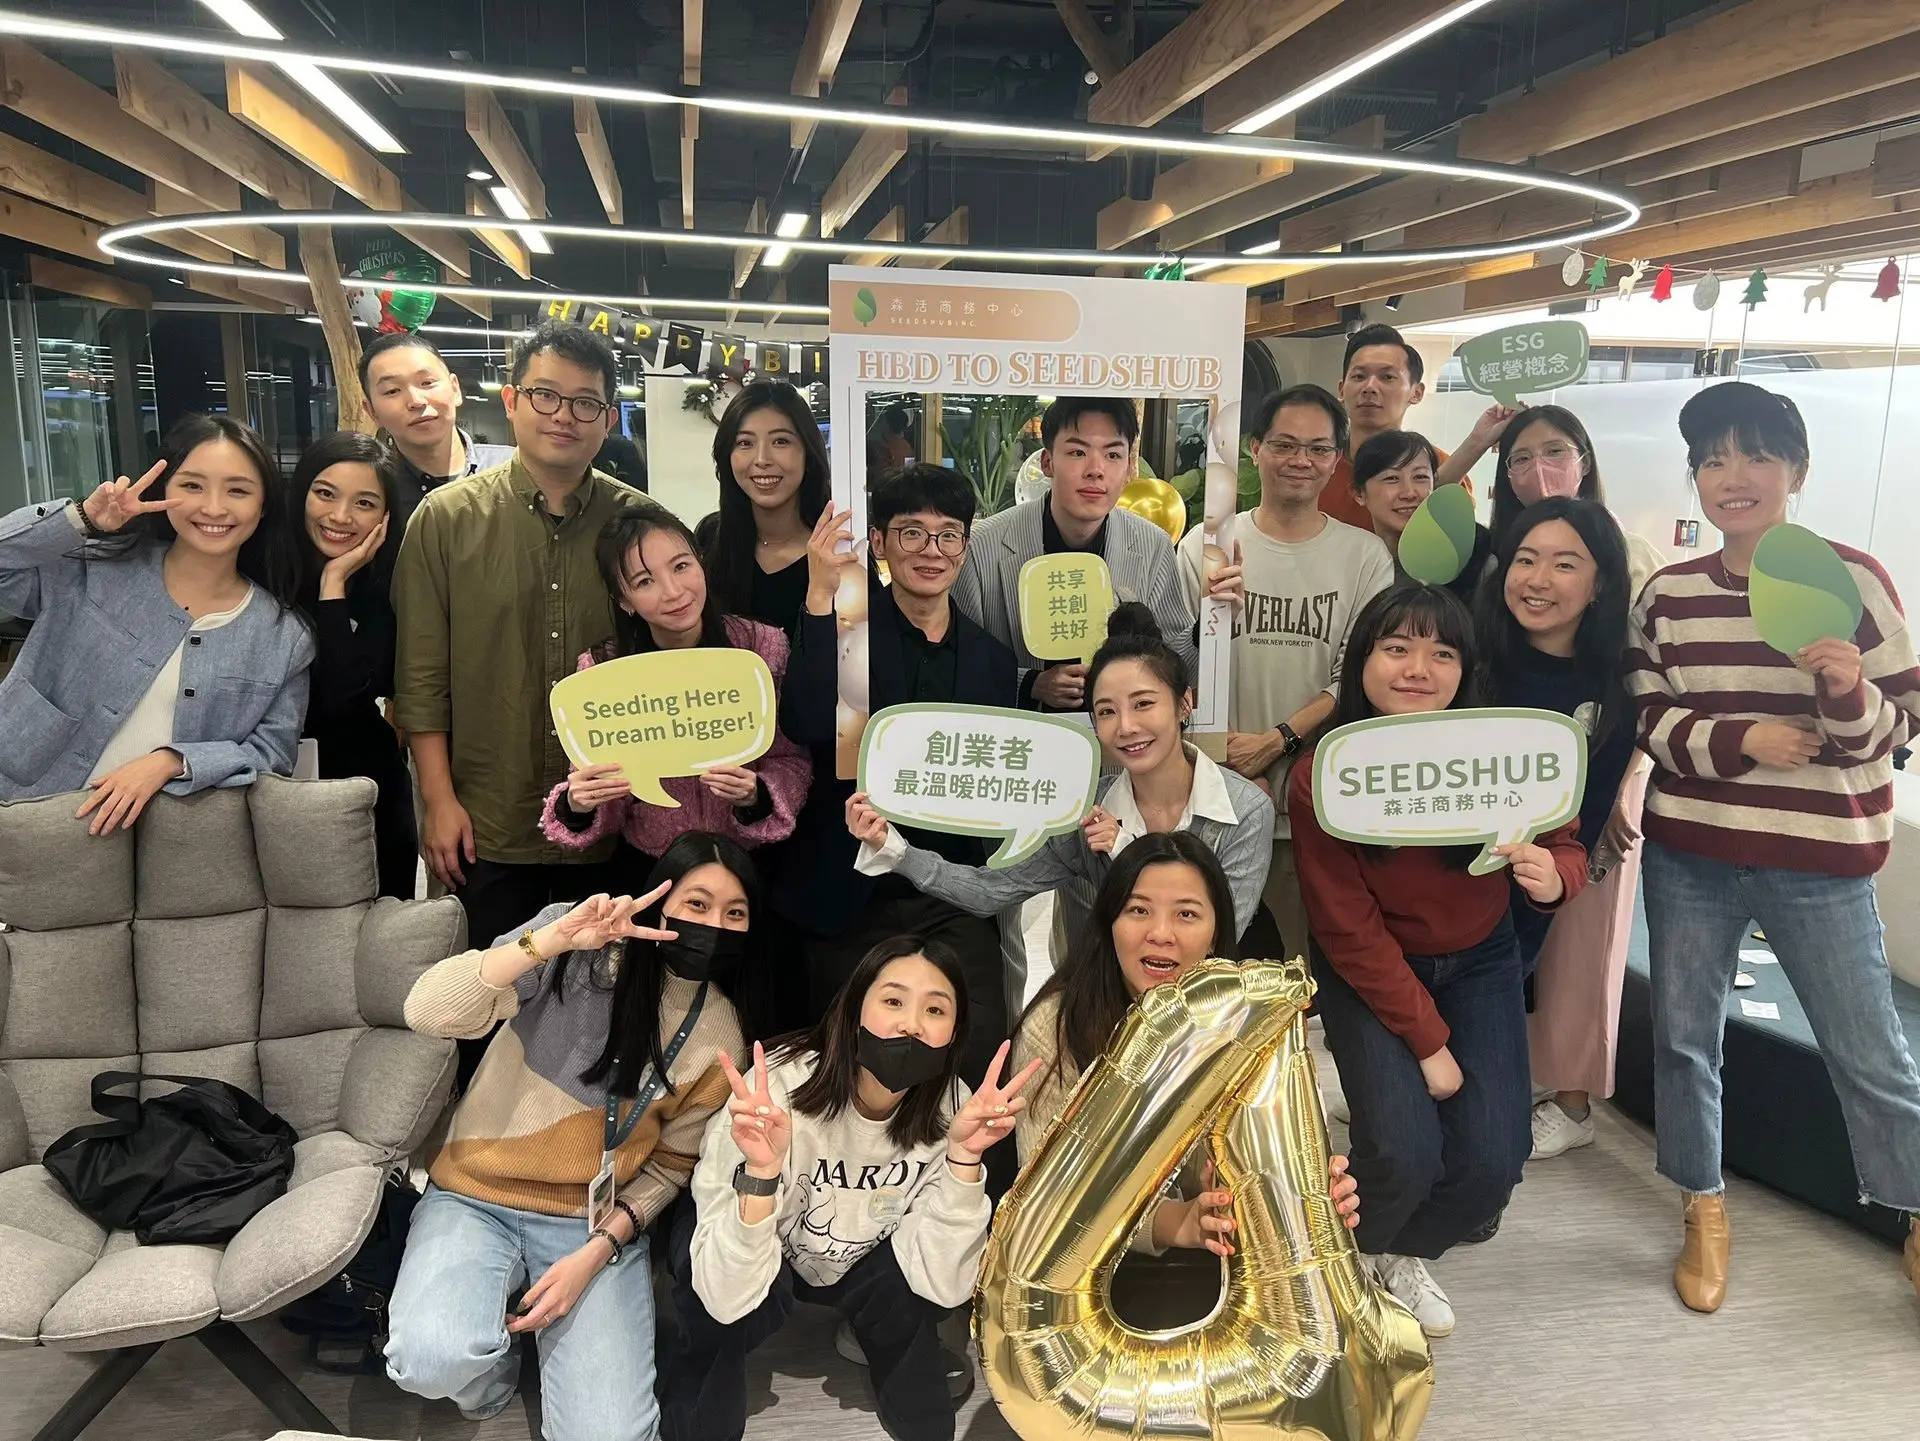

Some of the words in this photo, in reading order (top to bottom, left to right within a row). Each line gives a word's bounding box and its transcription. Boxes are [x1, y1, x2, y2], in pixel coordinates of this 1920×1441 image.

[359, 250, 406, 272] CHRISTMAS
[890, 298, 1023, 317] 森活商務中心
[548, 299, 737, 366] HAPPY
[1501, 331, 1545, 354] ESG
[856, 348, 941, 384] HBD
[946, 352, 1000, 386] TO
[1008, 350, 1222, 392] SEEDSHUB
[1479, 352, 1570, 384] 經營概念
[1047, 568, 1086, 592] 共享
[1048, 593, 1088, 617] 共創
[1050, 618, 1089, 642] 共好
[1285, 639, 1301, 648] YORK
[1301, 640, 1314, 648] CITY
[583, 693, 681, 721] Seeding
[684, 688, 741, 709] Here
[588, 725, 666, 748] Dream
[671, 711, 755, 741] bigger!
[924, 730, 1034, 771] 創業者
[893, 769, 1058, 806] 最溫暖的陪伴
[1338, 752, 1561, 797] SEEDSHUB
[1383, 790, 1523, 817] 森活商務中心
